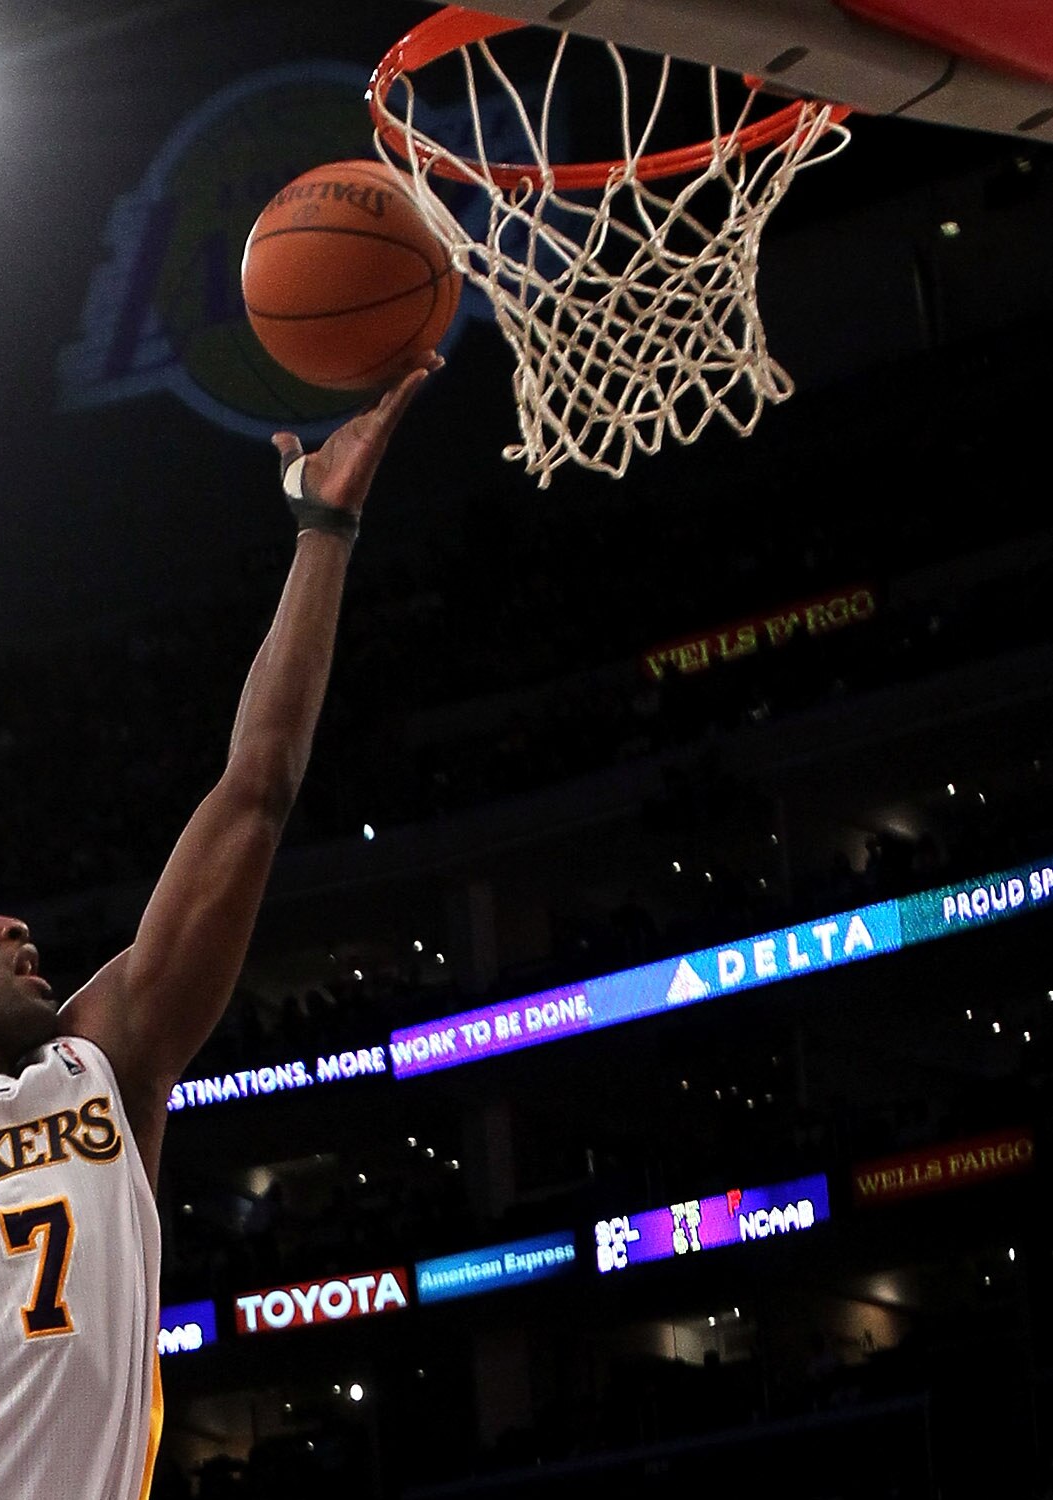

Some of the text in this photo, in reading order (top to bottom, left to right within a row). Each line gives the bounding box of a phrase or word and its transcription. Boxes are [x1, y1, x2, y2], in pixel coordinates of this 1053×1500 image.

[942, 866, 1053, 924] PROUD SP
[718, 915, 874, 988] DELTA
[166, 993, 593, 1111] STINATIONS. MORE WORK TO BE DONE.
[856, 1138, 1034, 1196] WELLS FARGO
[739, 1199, 815, 1242] NCAAB
[419, 1241, 577, 1291] American Express
[237, 1272, 407, 1332] TOYOTA
